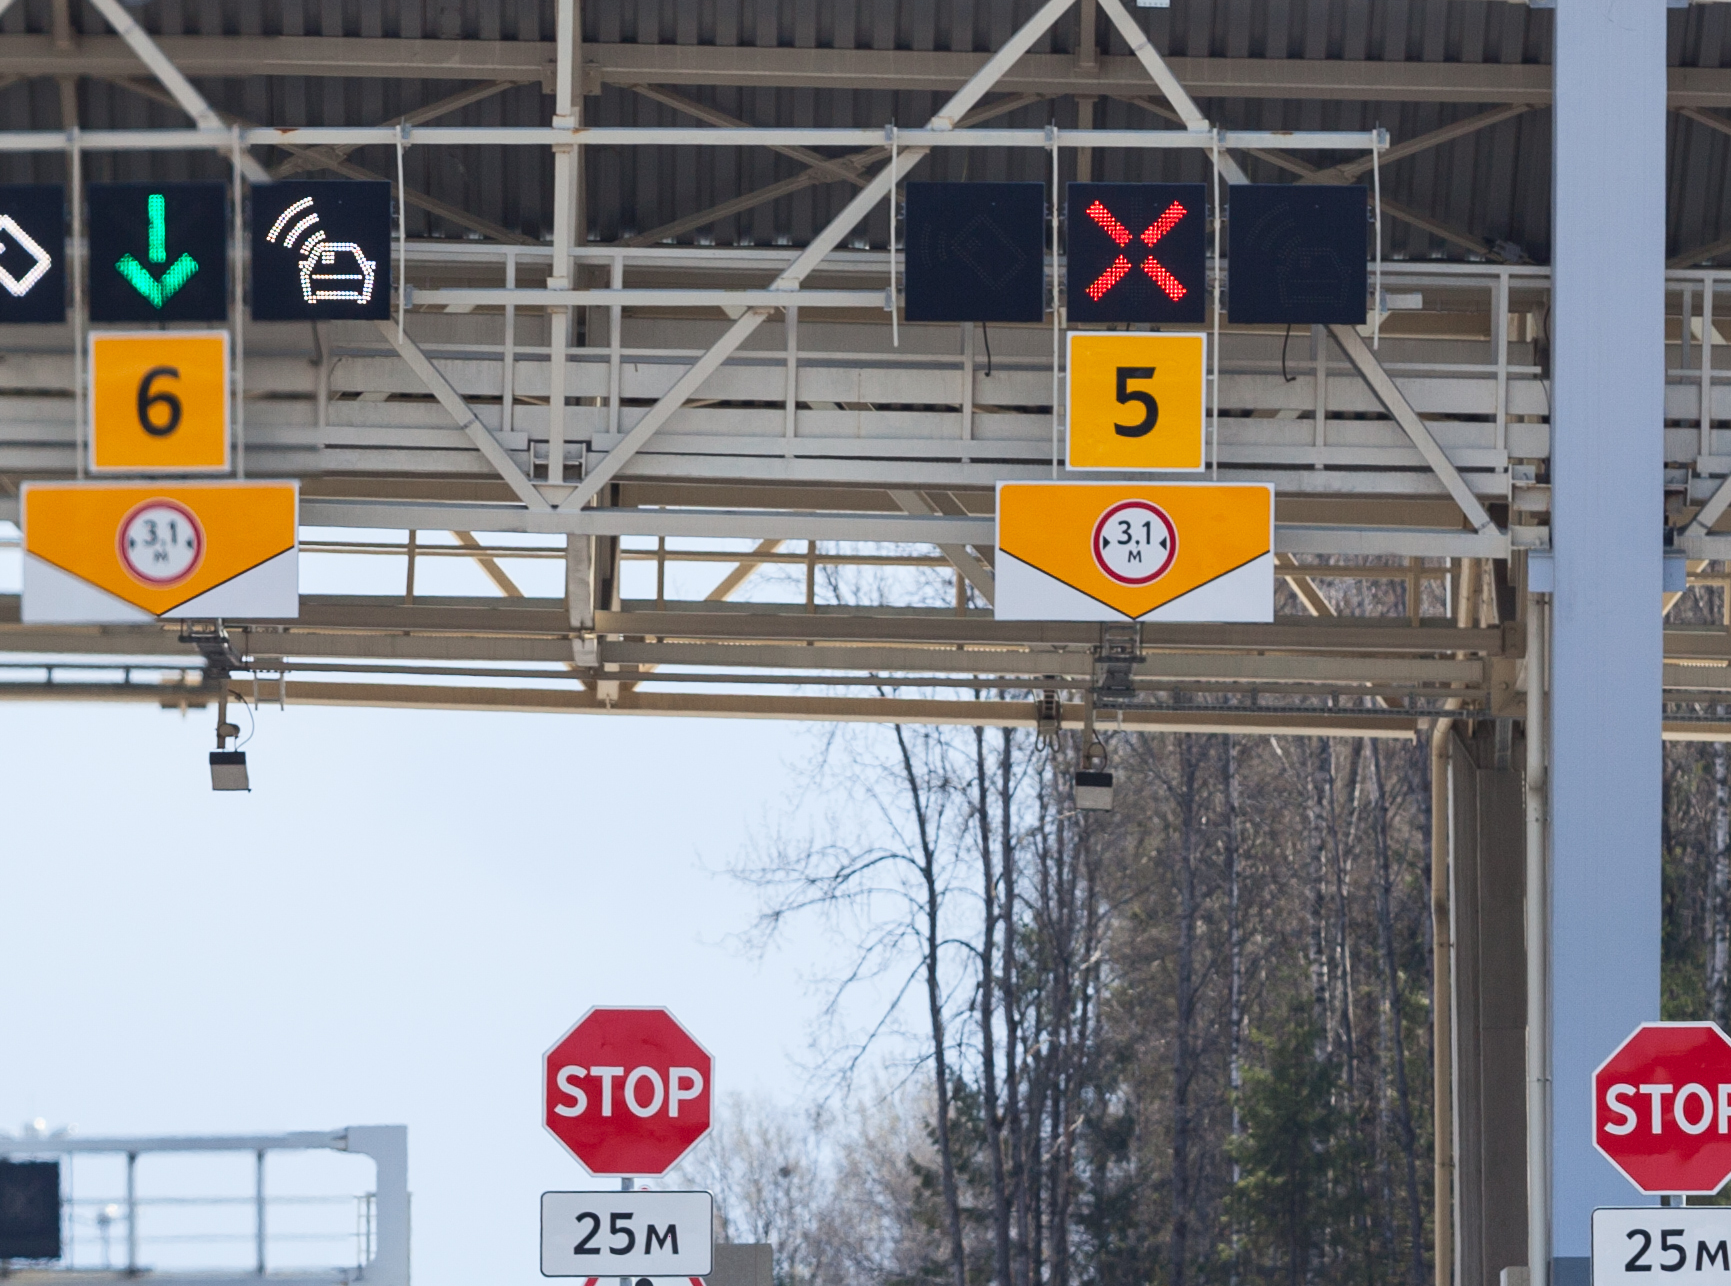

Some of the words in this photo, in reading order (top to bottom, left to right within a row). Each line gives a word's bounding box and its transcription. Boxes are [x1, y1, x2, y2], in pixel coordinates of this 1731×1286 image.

[135, 366, 183, 439] 6
[1113, 366, 1160, 439] 5
[143, 519, 177, 547] 3,1
[1117, 520, 1151, 549] 3,1
[553, 1065, 705, 1118] STOP
